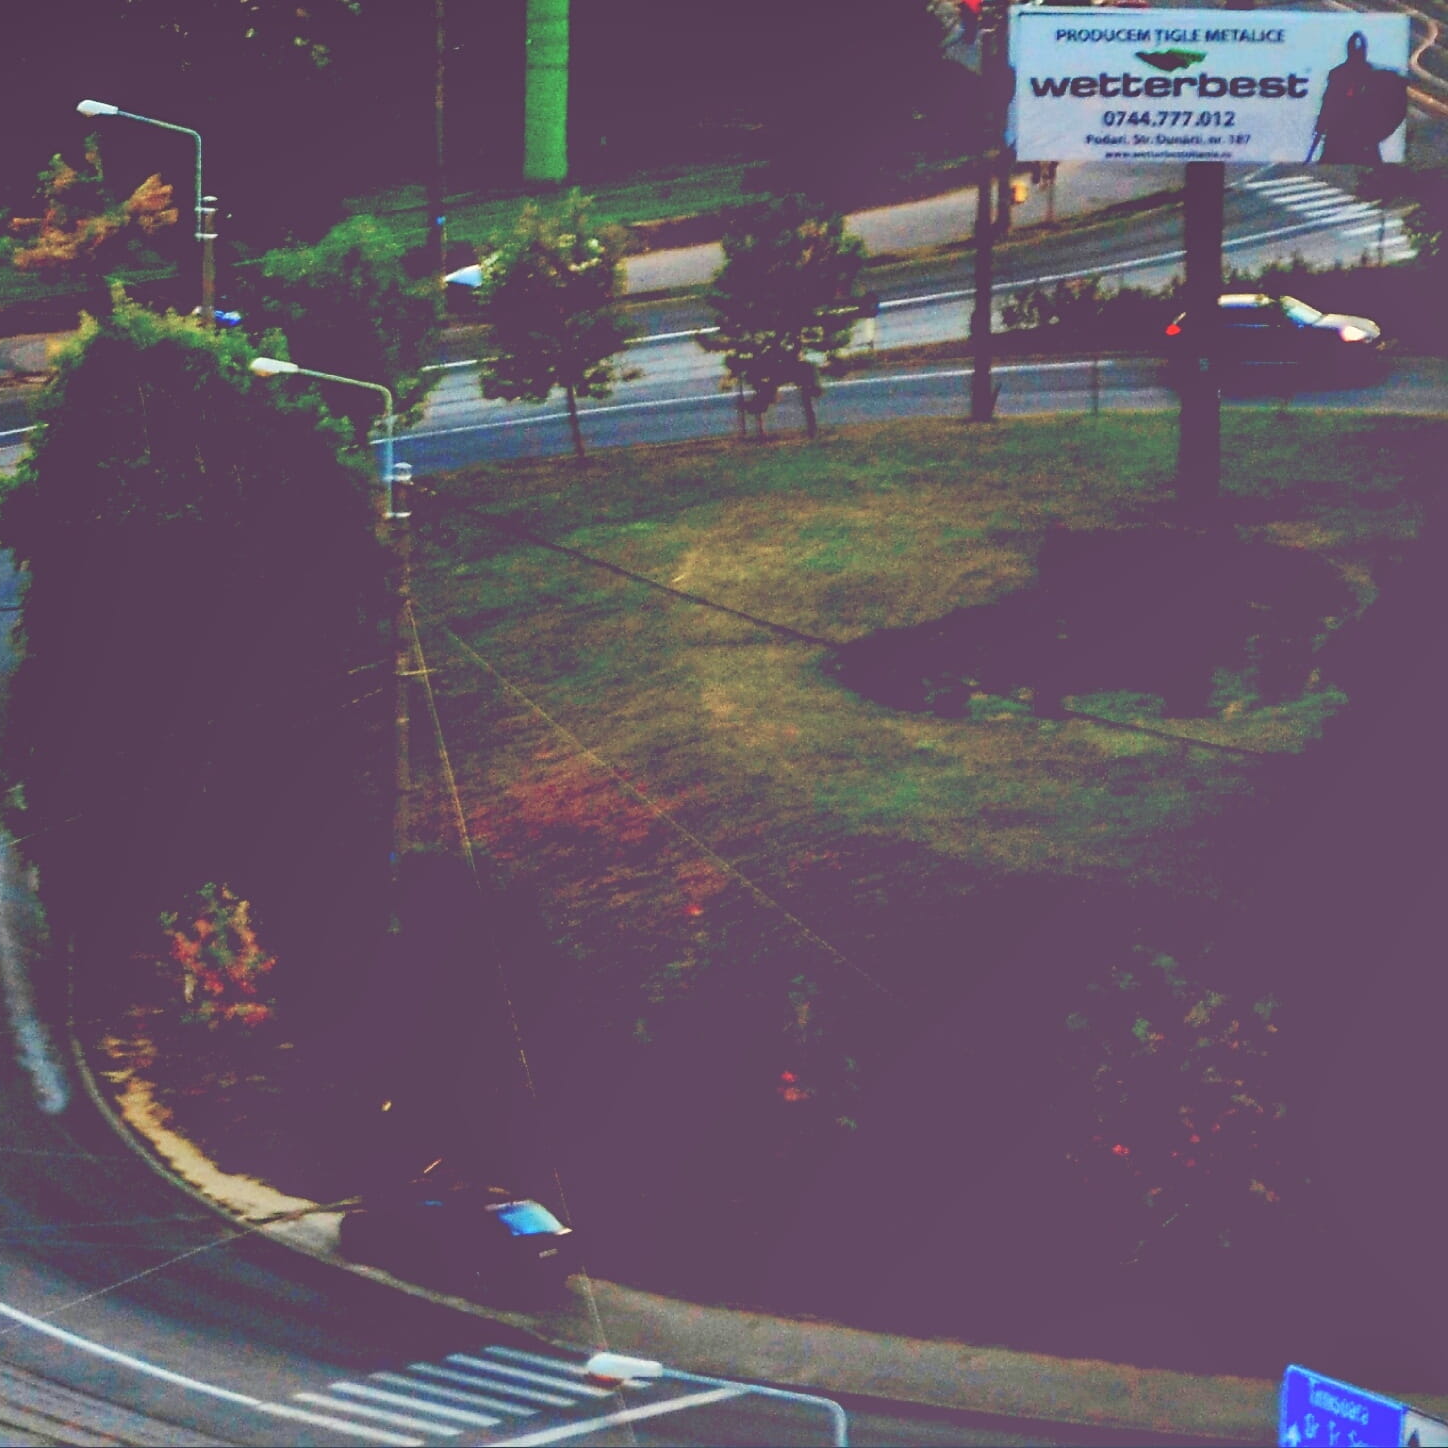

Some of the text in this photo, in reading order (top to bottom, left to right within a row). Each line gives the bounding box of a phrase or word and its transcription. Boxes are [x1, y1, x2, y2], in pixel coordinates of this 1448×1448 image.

[1055, 28, 1152, 43] PRODUCEM
[1205, 28, 1286, 44] METALICE
[1030, 72, 1309, 99] wetterbest
[1103, 110, 1236, 128] 0744.777.012
